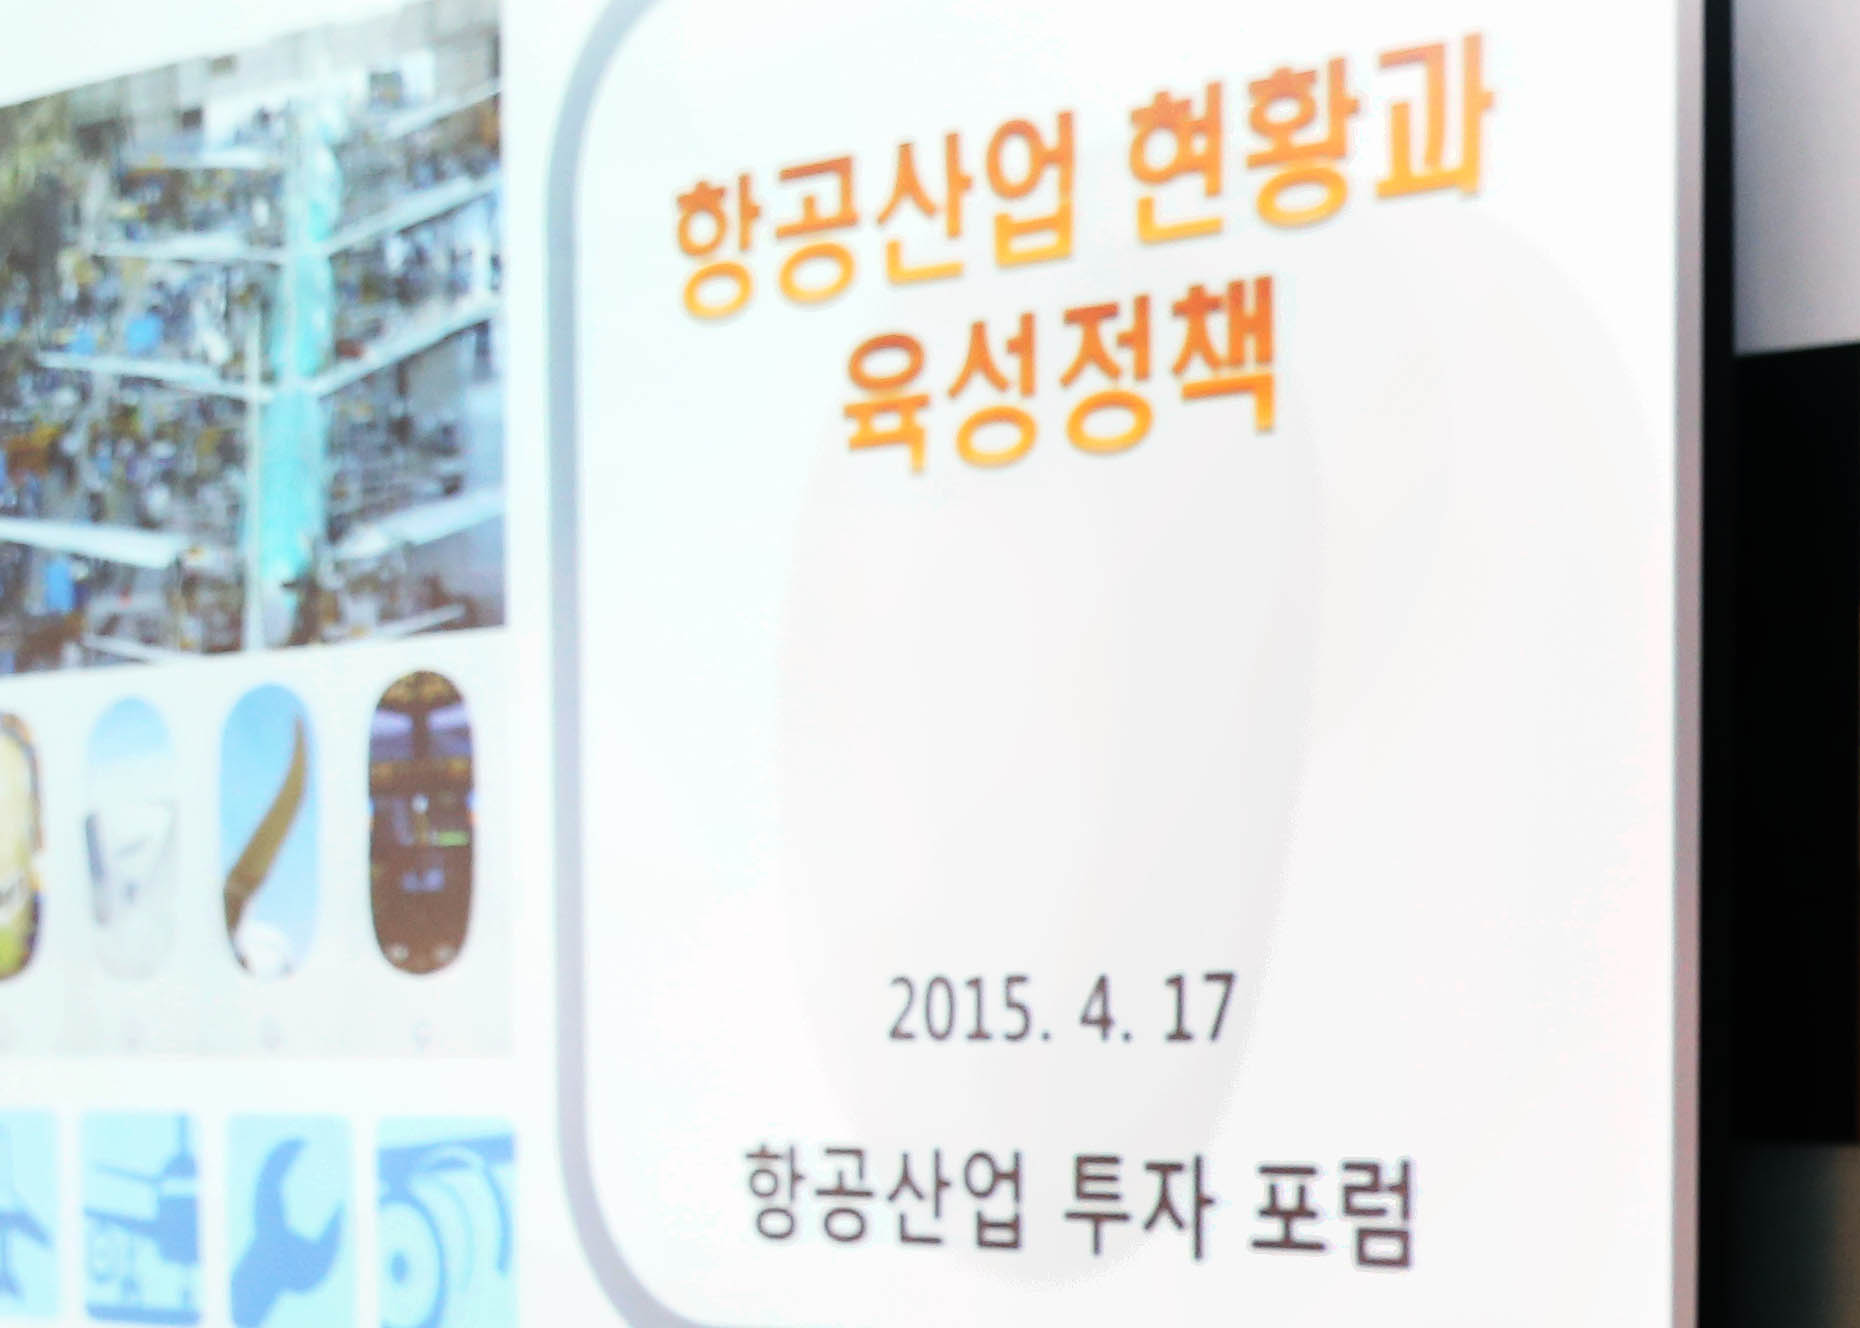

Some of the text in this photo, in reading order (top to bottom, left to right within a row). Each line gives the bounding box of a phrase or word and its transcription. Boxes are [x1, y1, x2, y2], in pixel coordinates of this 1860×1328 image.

[676, 33, 1494, 320] 항공산업 현황과
[843, 276, 1277, 473] 육성정책
[888, 971, 1236, 1043] 2015. 4. 17
[744, 1144, 1413, 1270] 항공산업 투자 포럼
